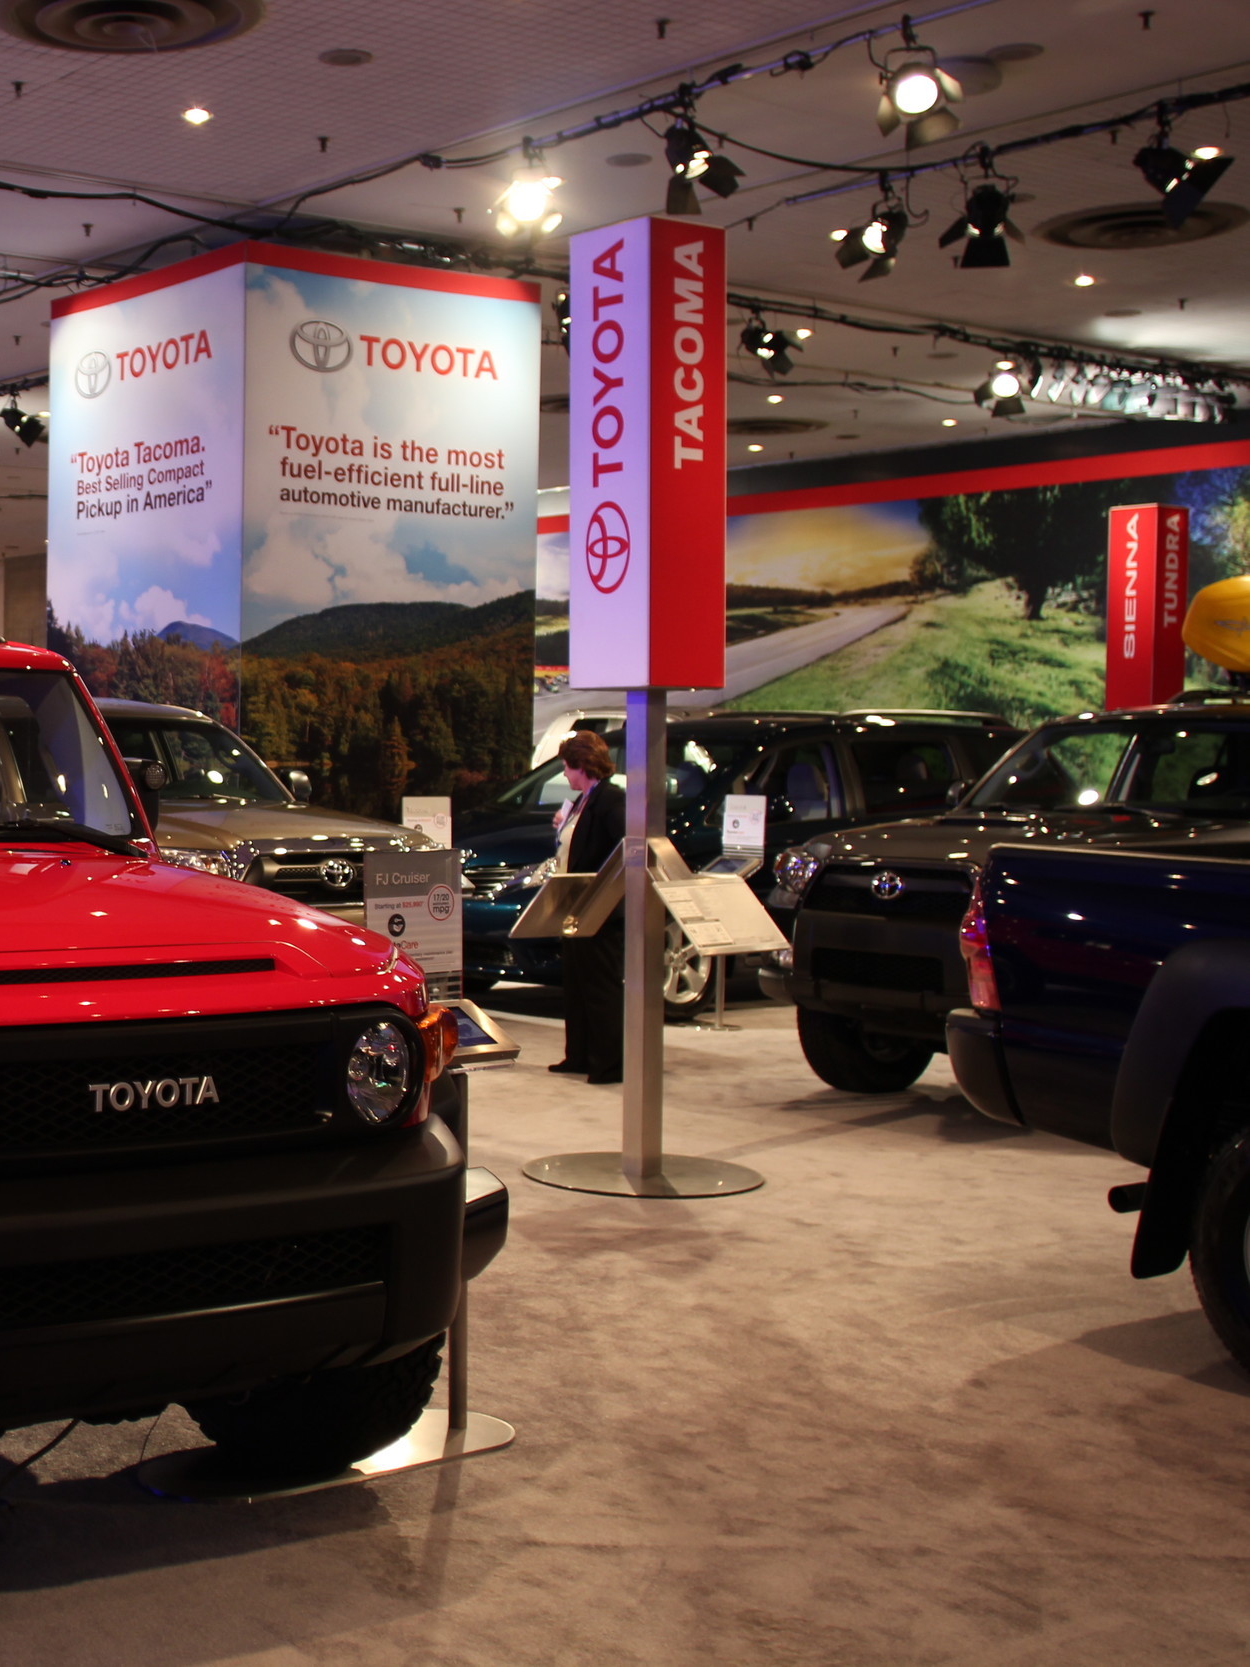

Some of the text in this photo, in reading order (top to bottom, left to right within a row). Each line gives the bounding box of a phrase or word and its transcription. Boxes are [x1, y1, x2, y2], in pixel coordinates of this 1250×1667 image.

[116, 329, 212, 381] TOYOTA
[360, 334, 498, 380] TOYOTA
[592, 238, 624, 488] TOYOTA
[674, 240, 704, 469] TACOMA
[134, 435, 206, 466] Tacoma.
[269, 425, 505, 469] “Toyota is the most
[77, 460, 205, 496] Best Selling Compact
[280, 456, 504, 496] fuel-efficient full-line
[77, 498, 122, 520] Pickup
[127, 494, 138, 513] in
[280, 486, 381, 509] automotive
[1123, 513, 1139, 659] SIENNA
[1164, 513, 1180, 628] TUNDRA
[375, 872, 431, 885] FJ Cruiser
[89, 1075, 220, 1113] TOYOTA
